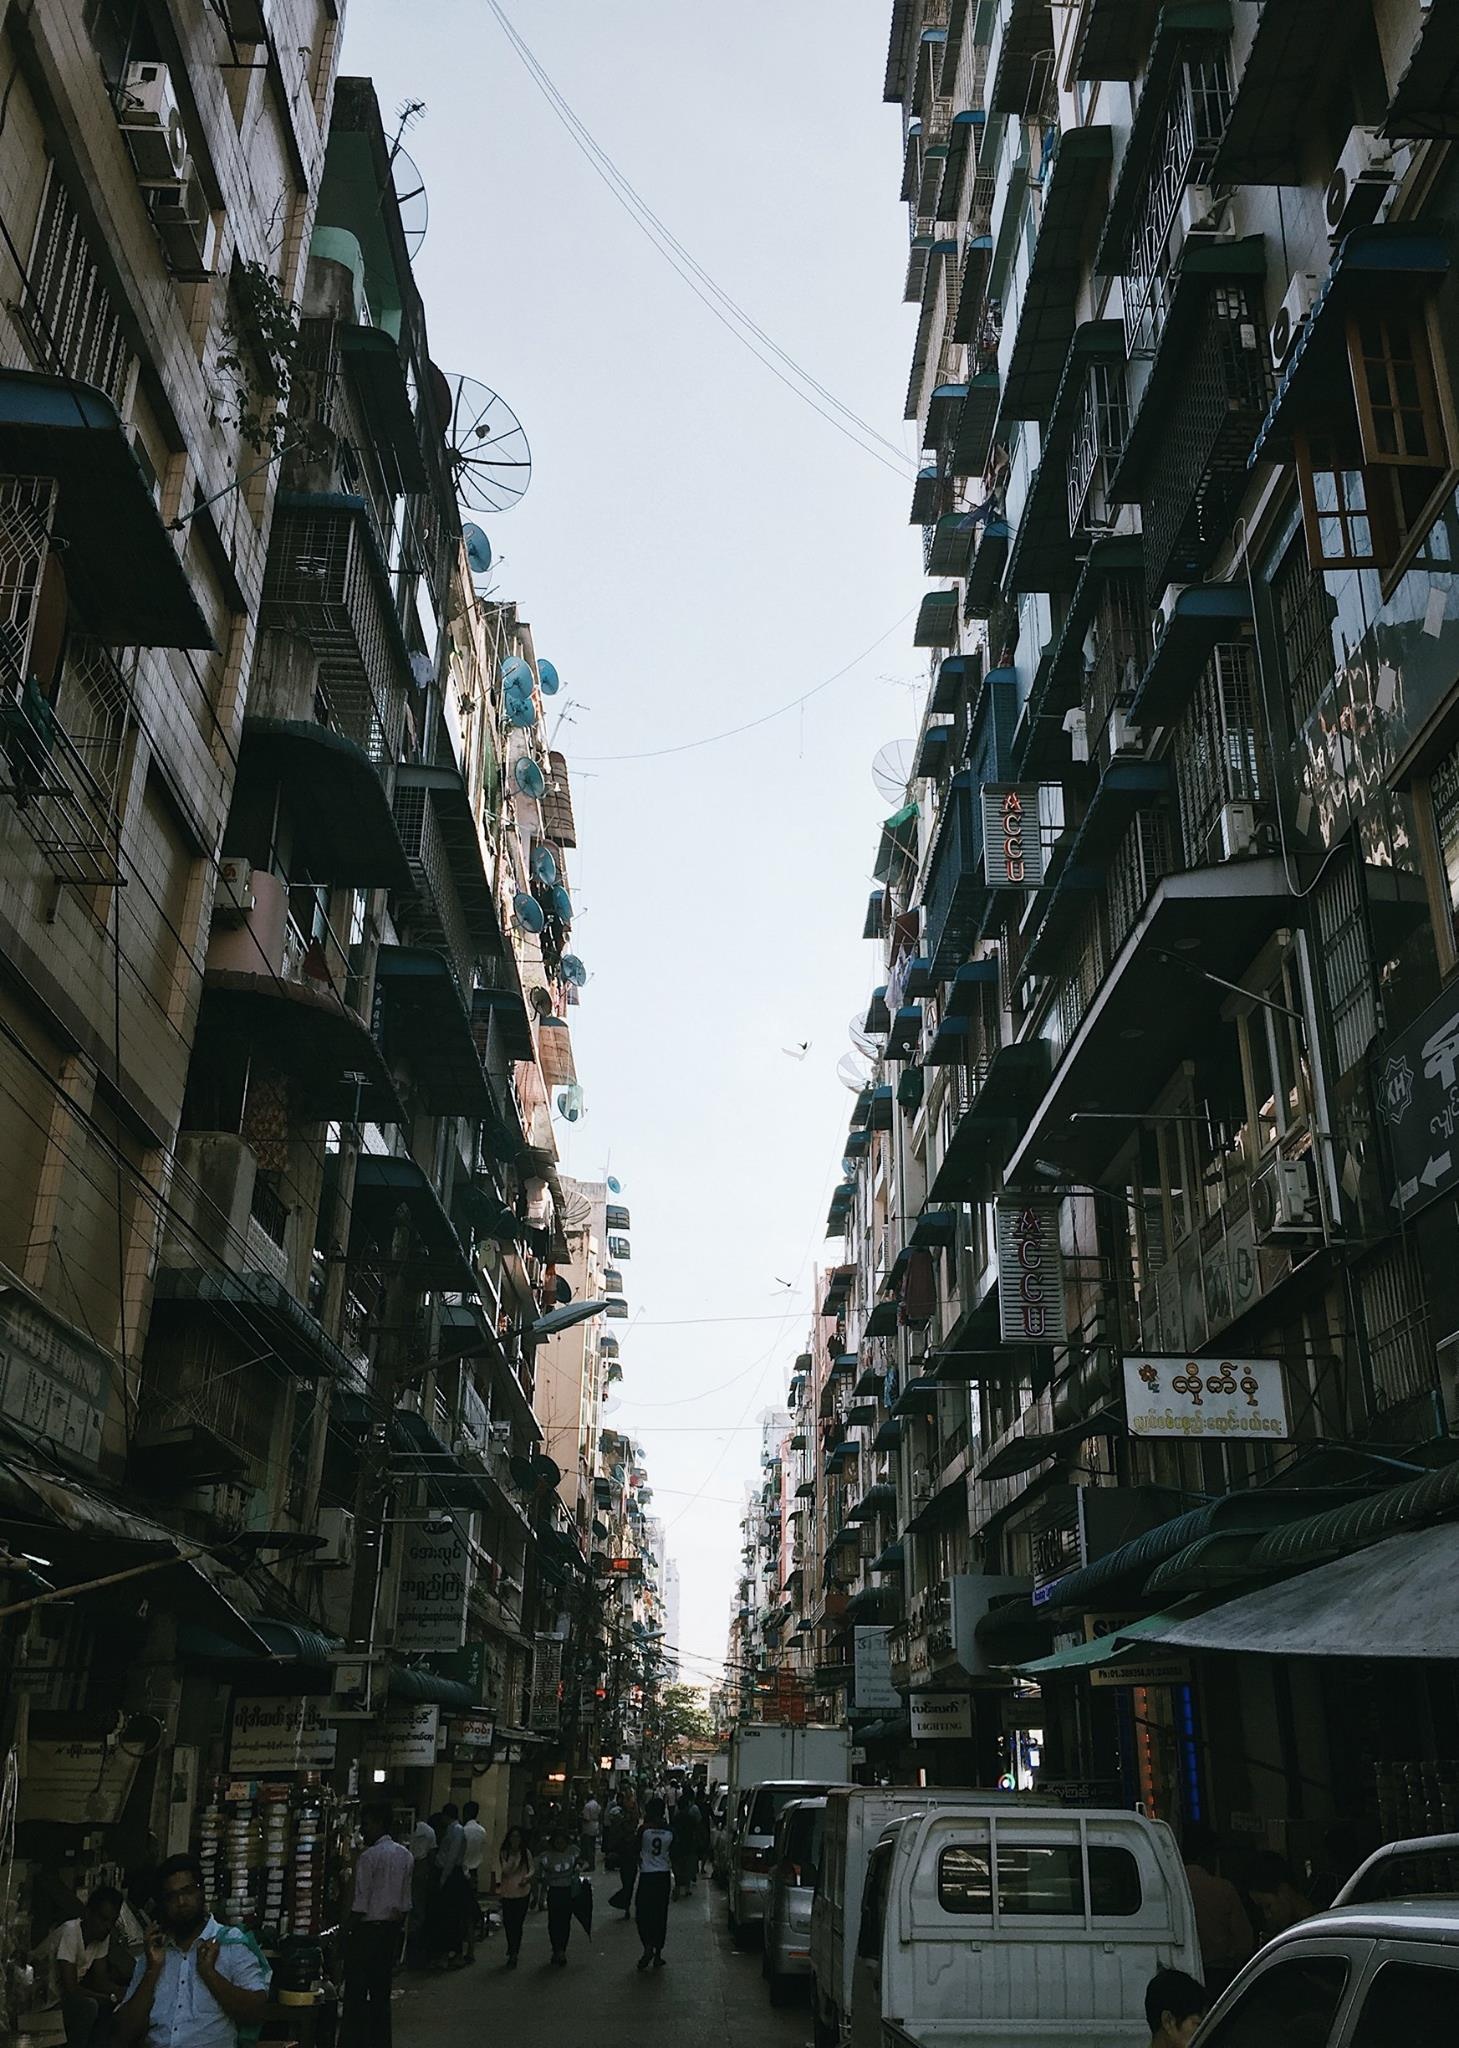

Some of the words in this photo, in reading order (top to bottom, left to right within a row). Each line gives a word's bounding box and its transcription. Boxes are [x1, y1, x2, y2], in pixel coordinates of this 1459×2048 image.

[1000, 791, 1025, 882] ACCU
[1013, 1208, 1046, 1338] ACCU
[917, 1722, 962, 1731] LIGHTING
[651, 1837, 662, 1856] 9
